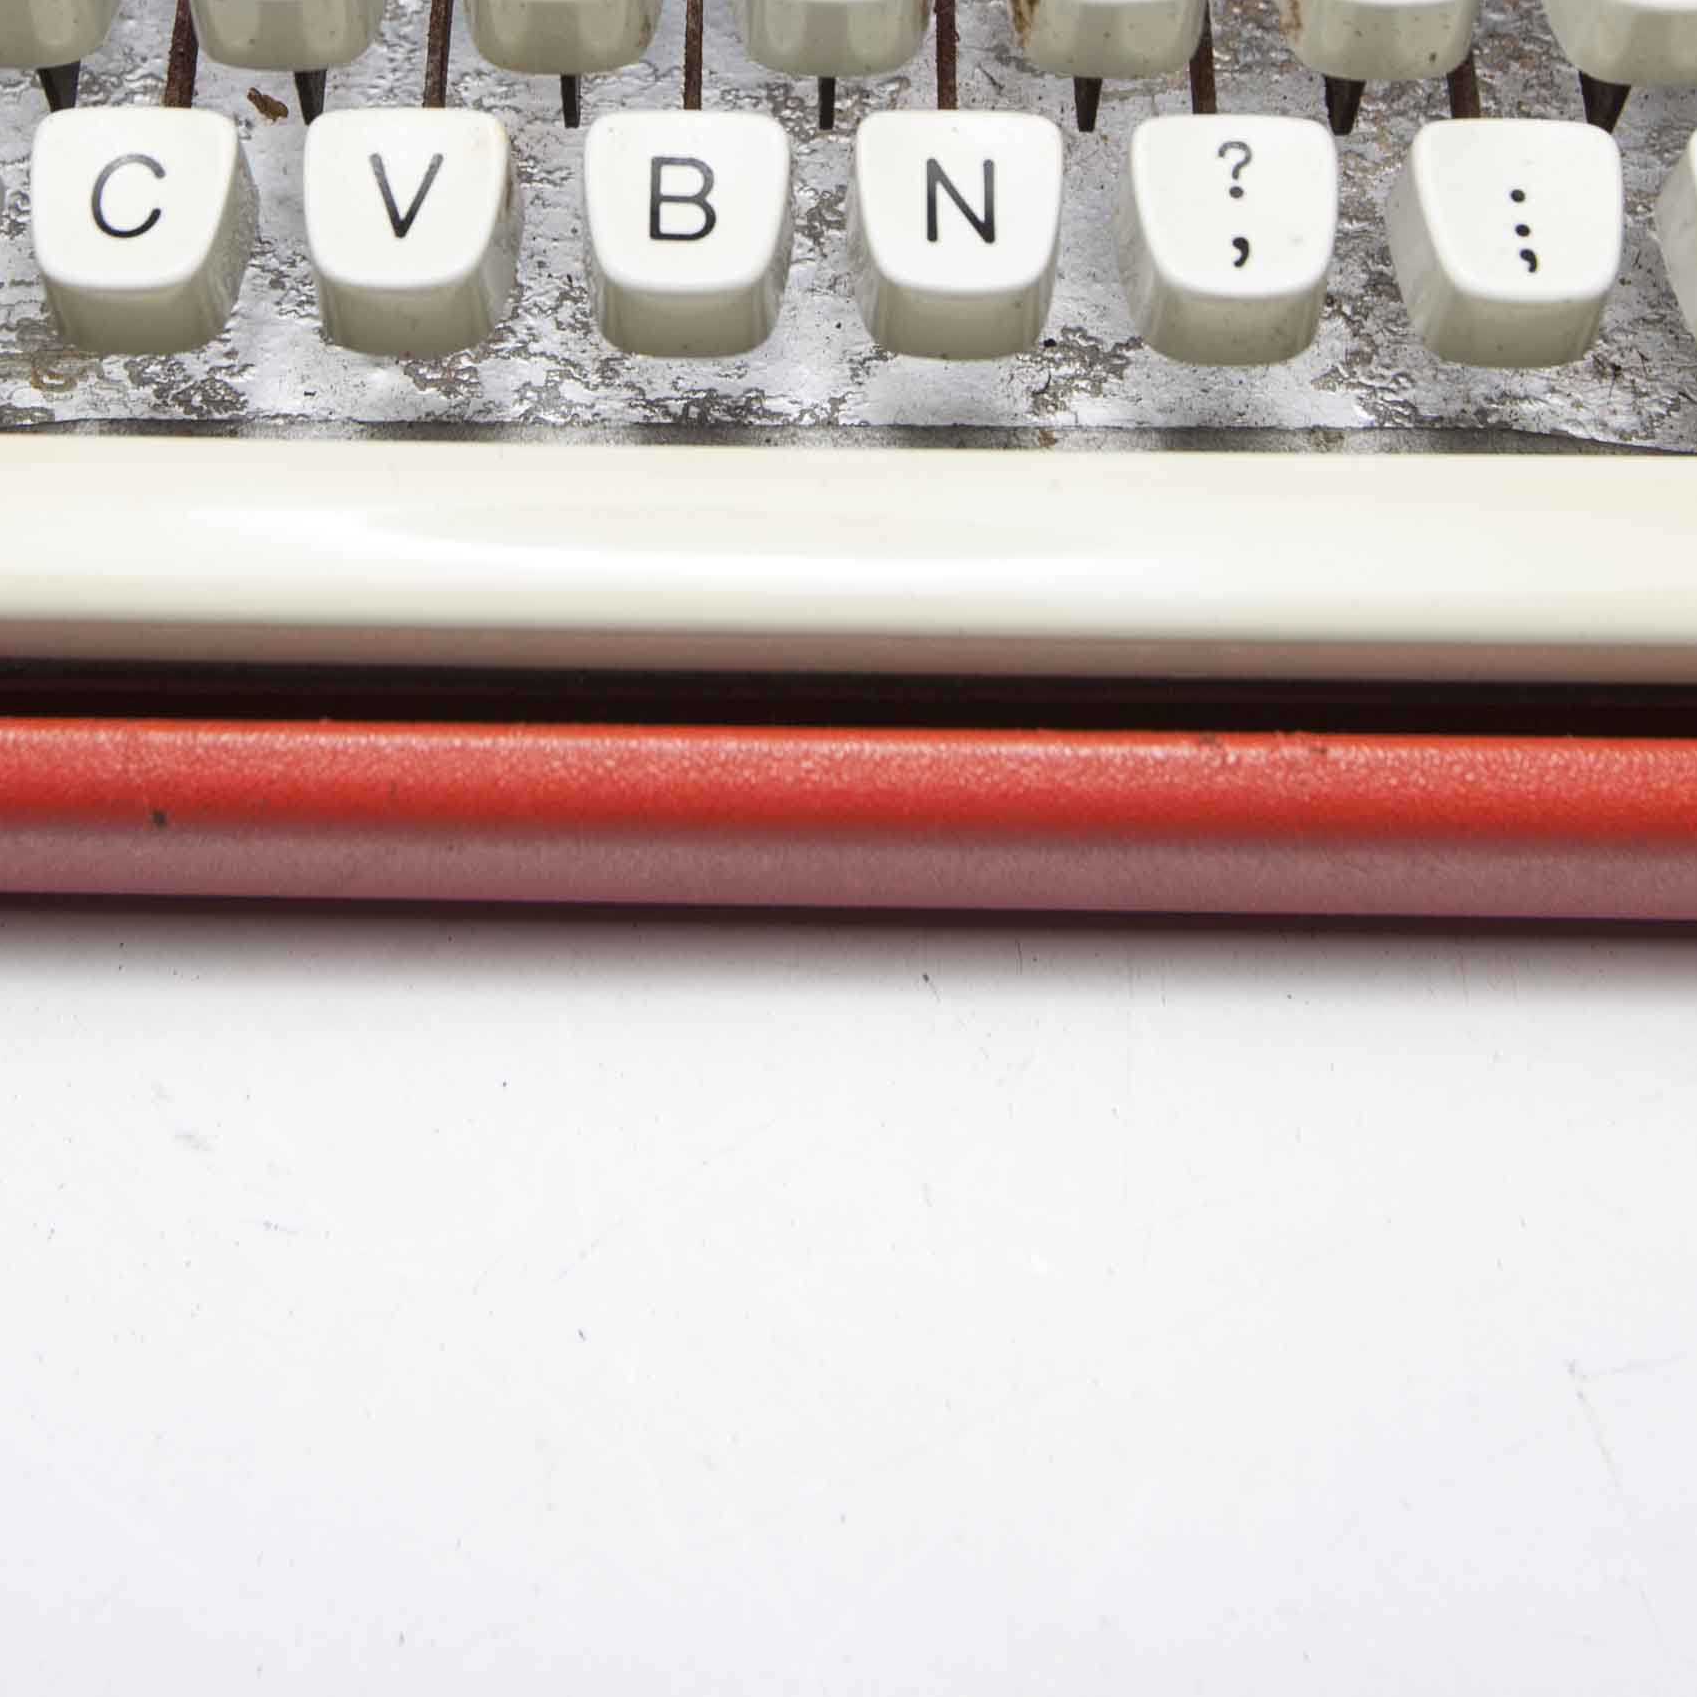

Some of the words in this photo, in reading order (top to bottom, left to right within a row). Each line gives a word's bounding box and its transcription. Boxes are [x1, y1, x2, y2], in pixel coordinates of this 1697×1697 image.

[90, 156, 166, 240] C
[373, 153, 444, 240] V
[648, 155, 718, 243] B
[925, 157, 997, 246] N
[1217, 140, 1252, 200] ?
